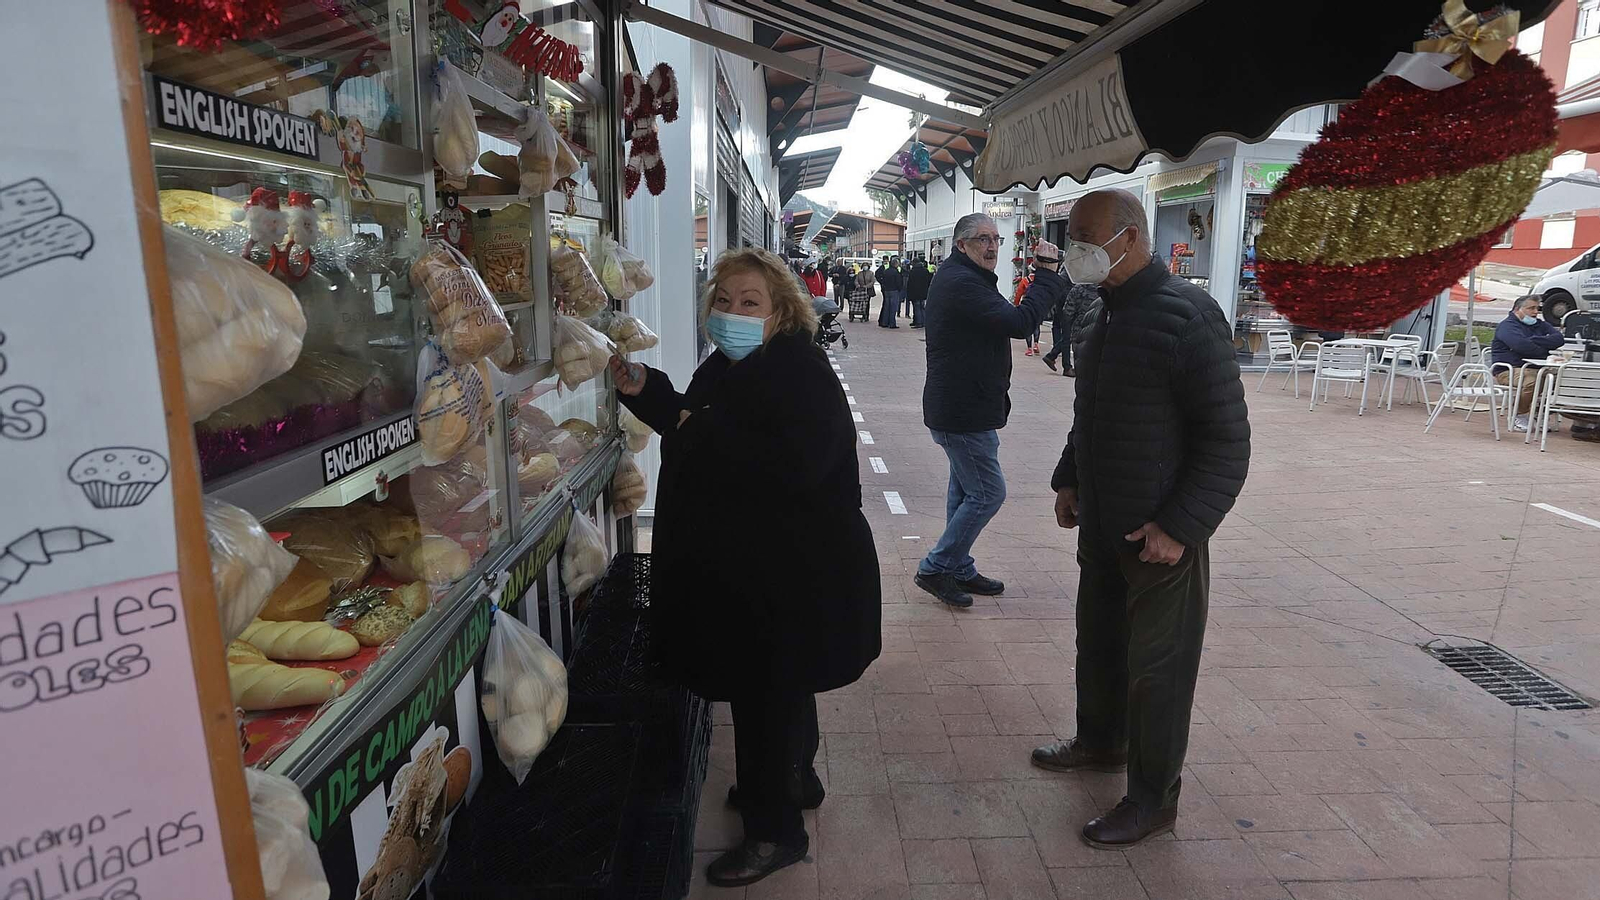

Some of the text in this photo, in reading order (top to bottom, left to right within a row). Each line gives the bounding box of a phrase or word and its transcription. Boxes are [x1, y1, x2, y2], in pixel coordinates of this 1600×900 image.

[160, 82, 316, 156] ENGLISH SPOKEN
[988, 208, 1012, 217] Andrea
[324, 416, 415, 482] ENGLISH SPOKEN
[328, 750, 361, 828] DE
[364, 677, 436, 782] CAMPO
[436, 661, 446, 708] A
[448, 638, 463, 691] LA
